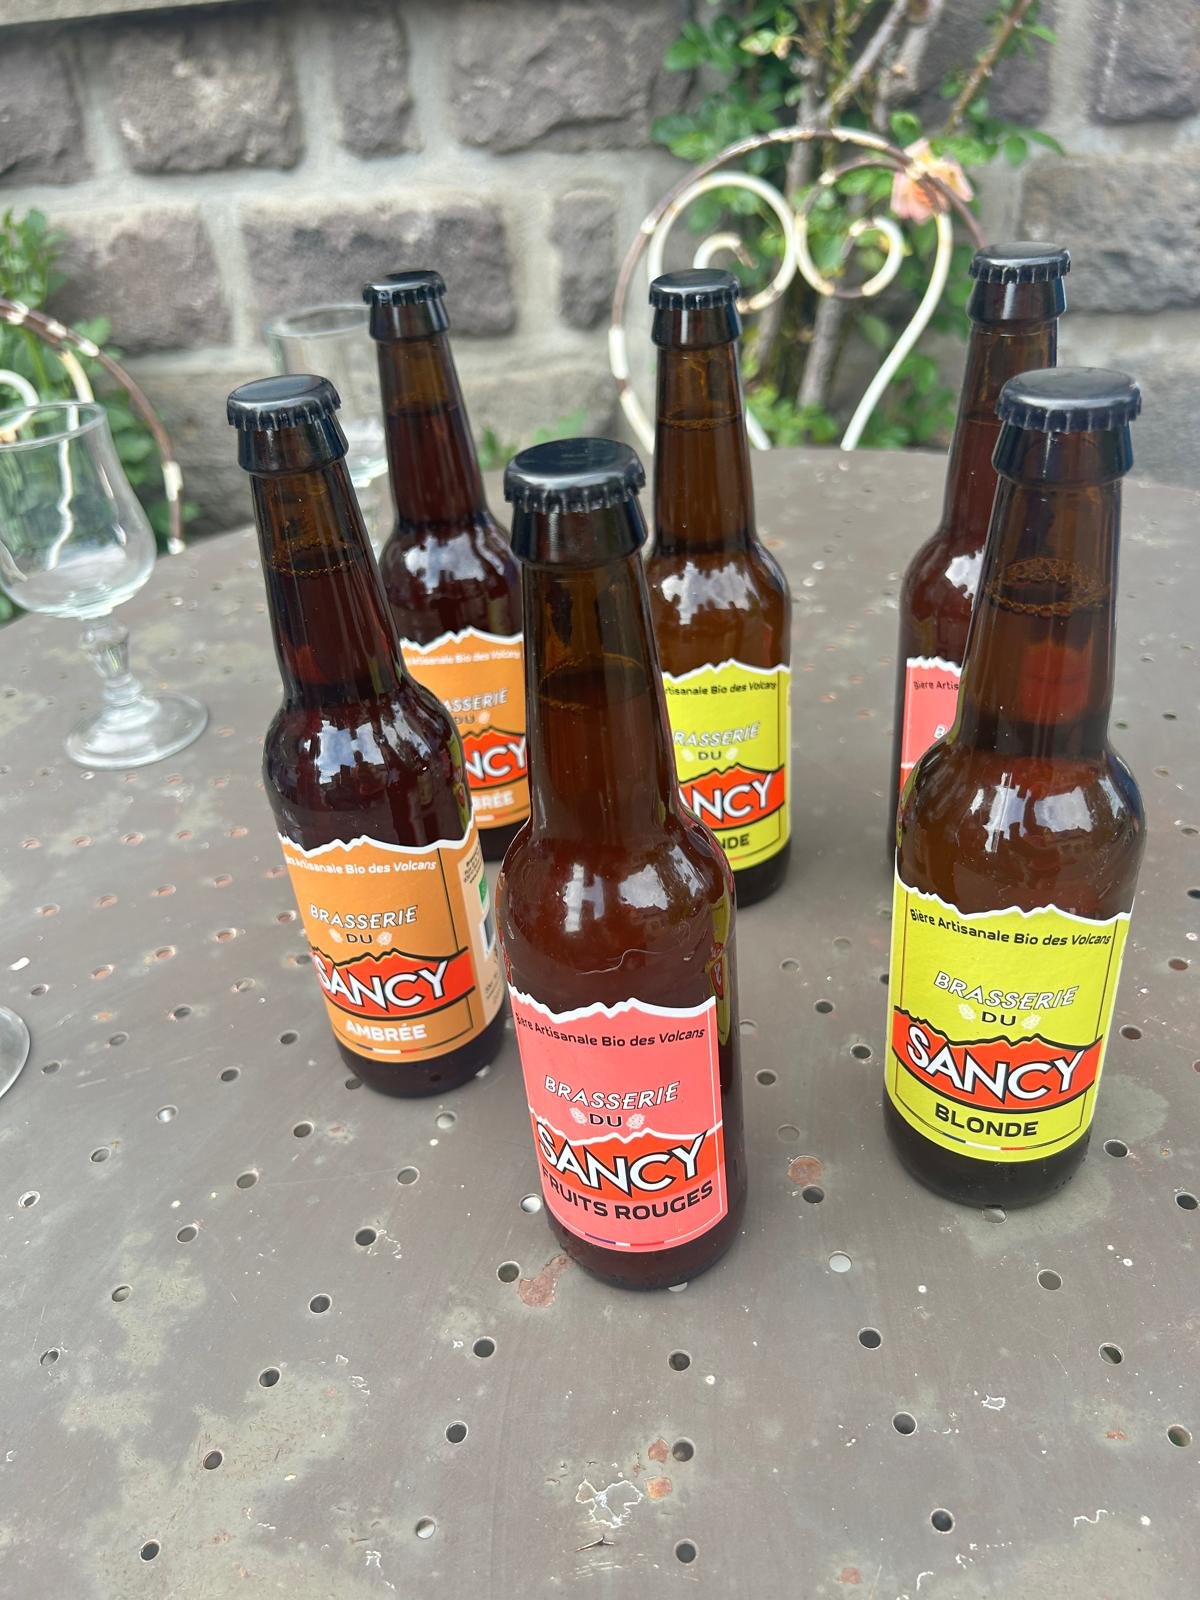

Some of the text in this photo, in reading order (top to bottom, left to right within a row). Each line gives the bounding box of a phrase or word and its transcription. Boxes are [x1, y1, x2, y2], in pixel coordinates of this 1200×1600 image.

[711, 685, 727, 694] Bio
[729, 684, 747, 693] des
[673, 721, 760, 747] RASSERIE
[466, 736, 527, 781] NCY
[698, 751, 722, 761] DU
[471, 790, 514, 811] BRÉE
[679, 773, 774, 823] NCY
[345, 863, 366, 874] Bio
[368, 863, 391, 874] des
[393, 860, 436, 872] Volcans
[309, 903, 418, 930] BRASSERIE
[910, 908, 1111, 945] Bière Artisanale Bio des Volcans
[346, 933, 373, 944] DU
[313, 955, 449, 1012] SANCY
[934, 971, 1079, 1011] BRASSERIE
[345, 1020, 428, 1042] AMBRÉE
[981, 1011, 1017, 1026] DU
[535, 1022, 598, 1046] Artisanale
[601, 1036, 626, 1047] Bio
[631, 1035, 656, 1047] des
[659, 1028, 705, 1044] Volcans
[906, 1024, 1085, 1103] SANCY
[544, 1075, 680, 1110] BRASSERIE
[589, 1113, 622, 1127] DU
[935, 1103, 1039, 1138] BLONDE
[537, 1121, 708, 1197] SANCY
[542, 1164, 713, 1220] FRUITS ROUGES
